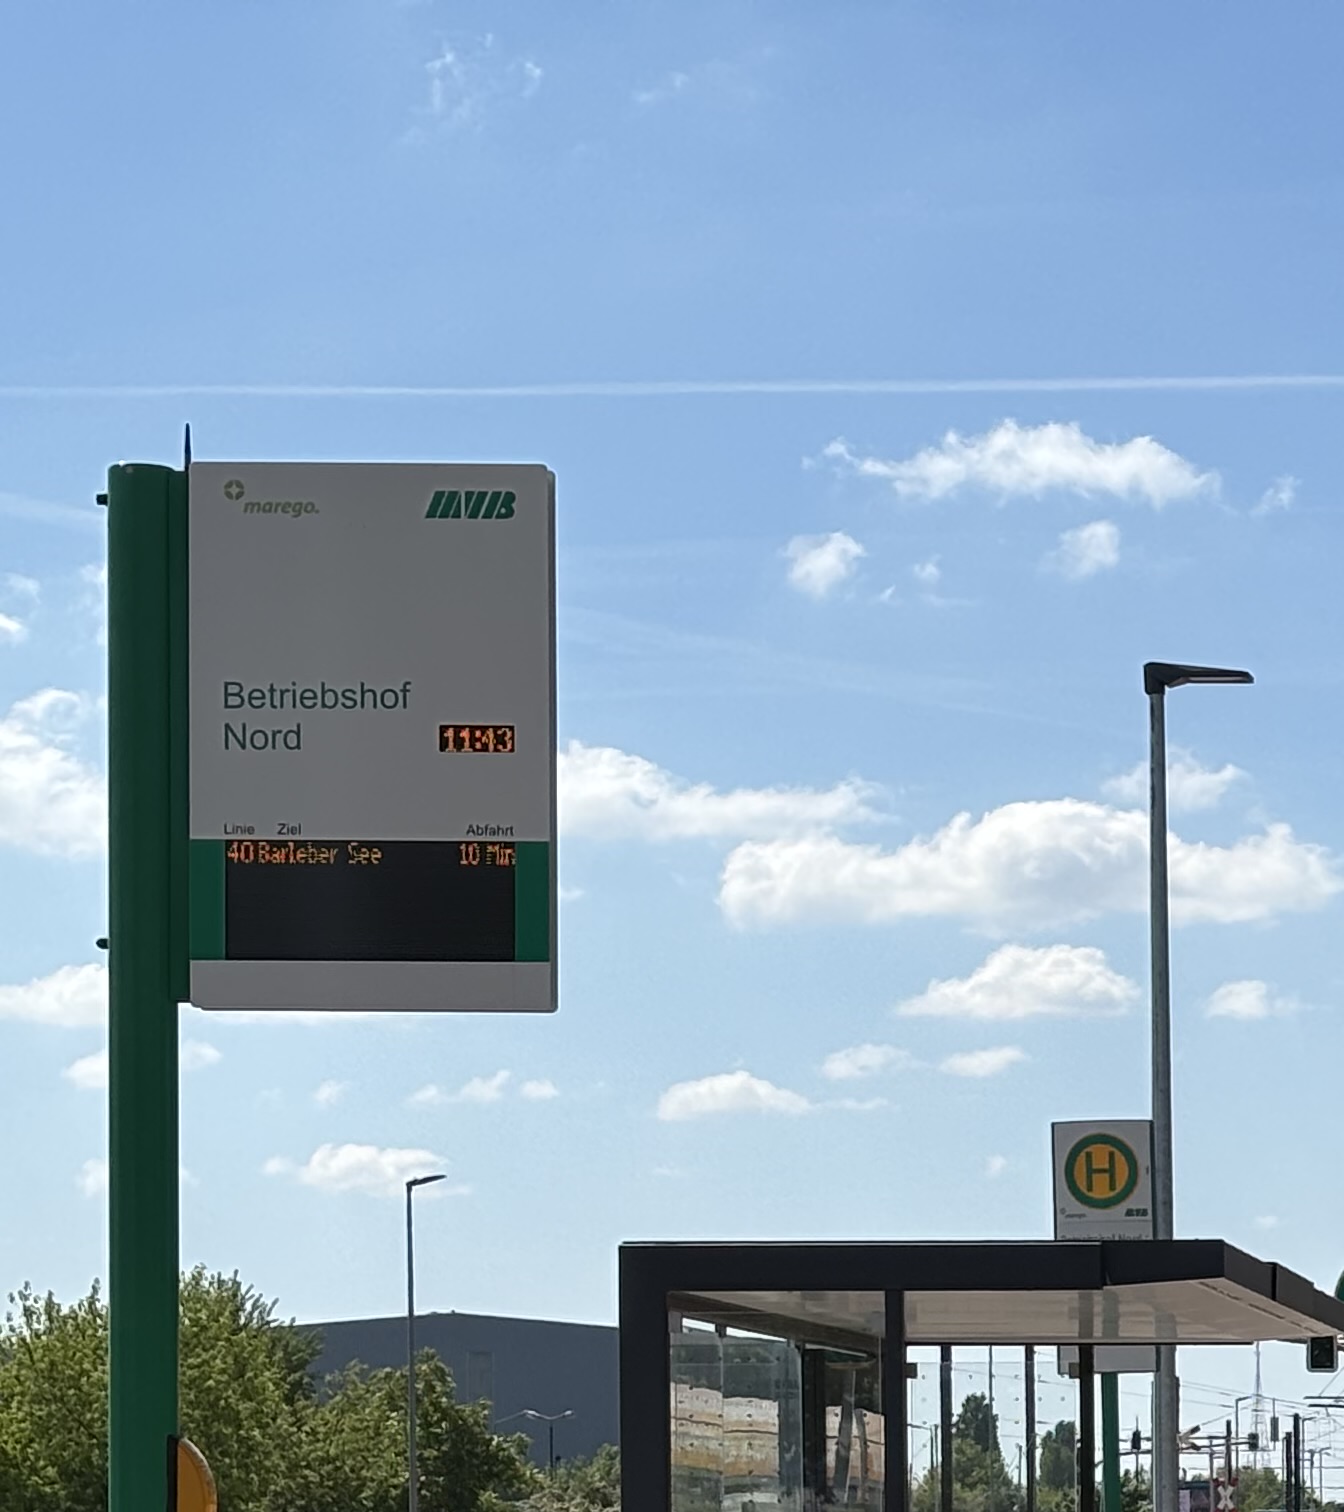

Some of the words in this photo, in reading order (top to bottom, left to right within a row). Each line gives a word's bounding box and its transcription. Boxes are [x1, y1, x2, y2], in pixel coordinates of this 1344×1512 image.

[424, 490, 517, 519] MVB
[223, 681, 411, 709] Betriebshof
[223, 722, 302, 751] Nord
[223, 823, 255, 836] Linie
[276, 823, 302, 836] Ziel
[466, 824, 515, 837] Abfahrt
[226, 841, 254, 865] 40
[347, 842, 383, 865] See
[1085, 1150, 1117, 1193] H
